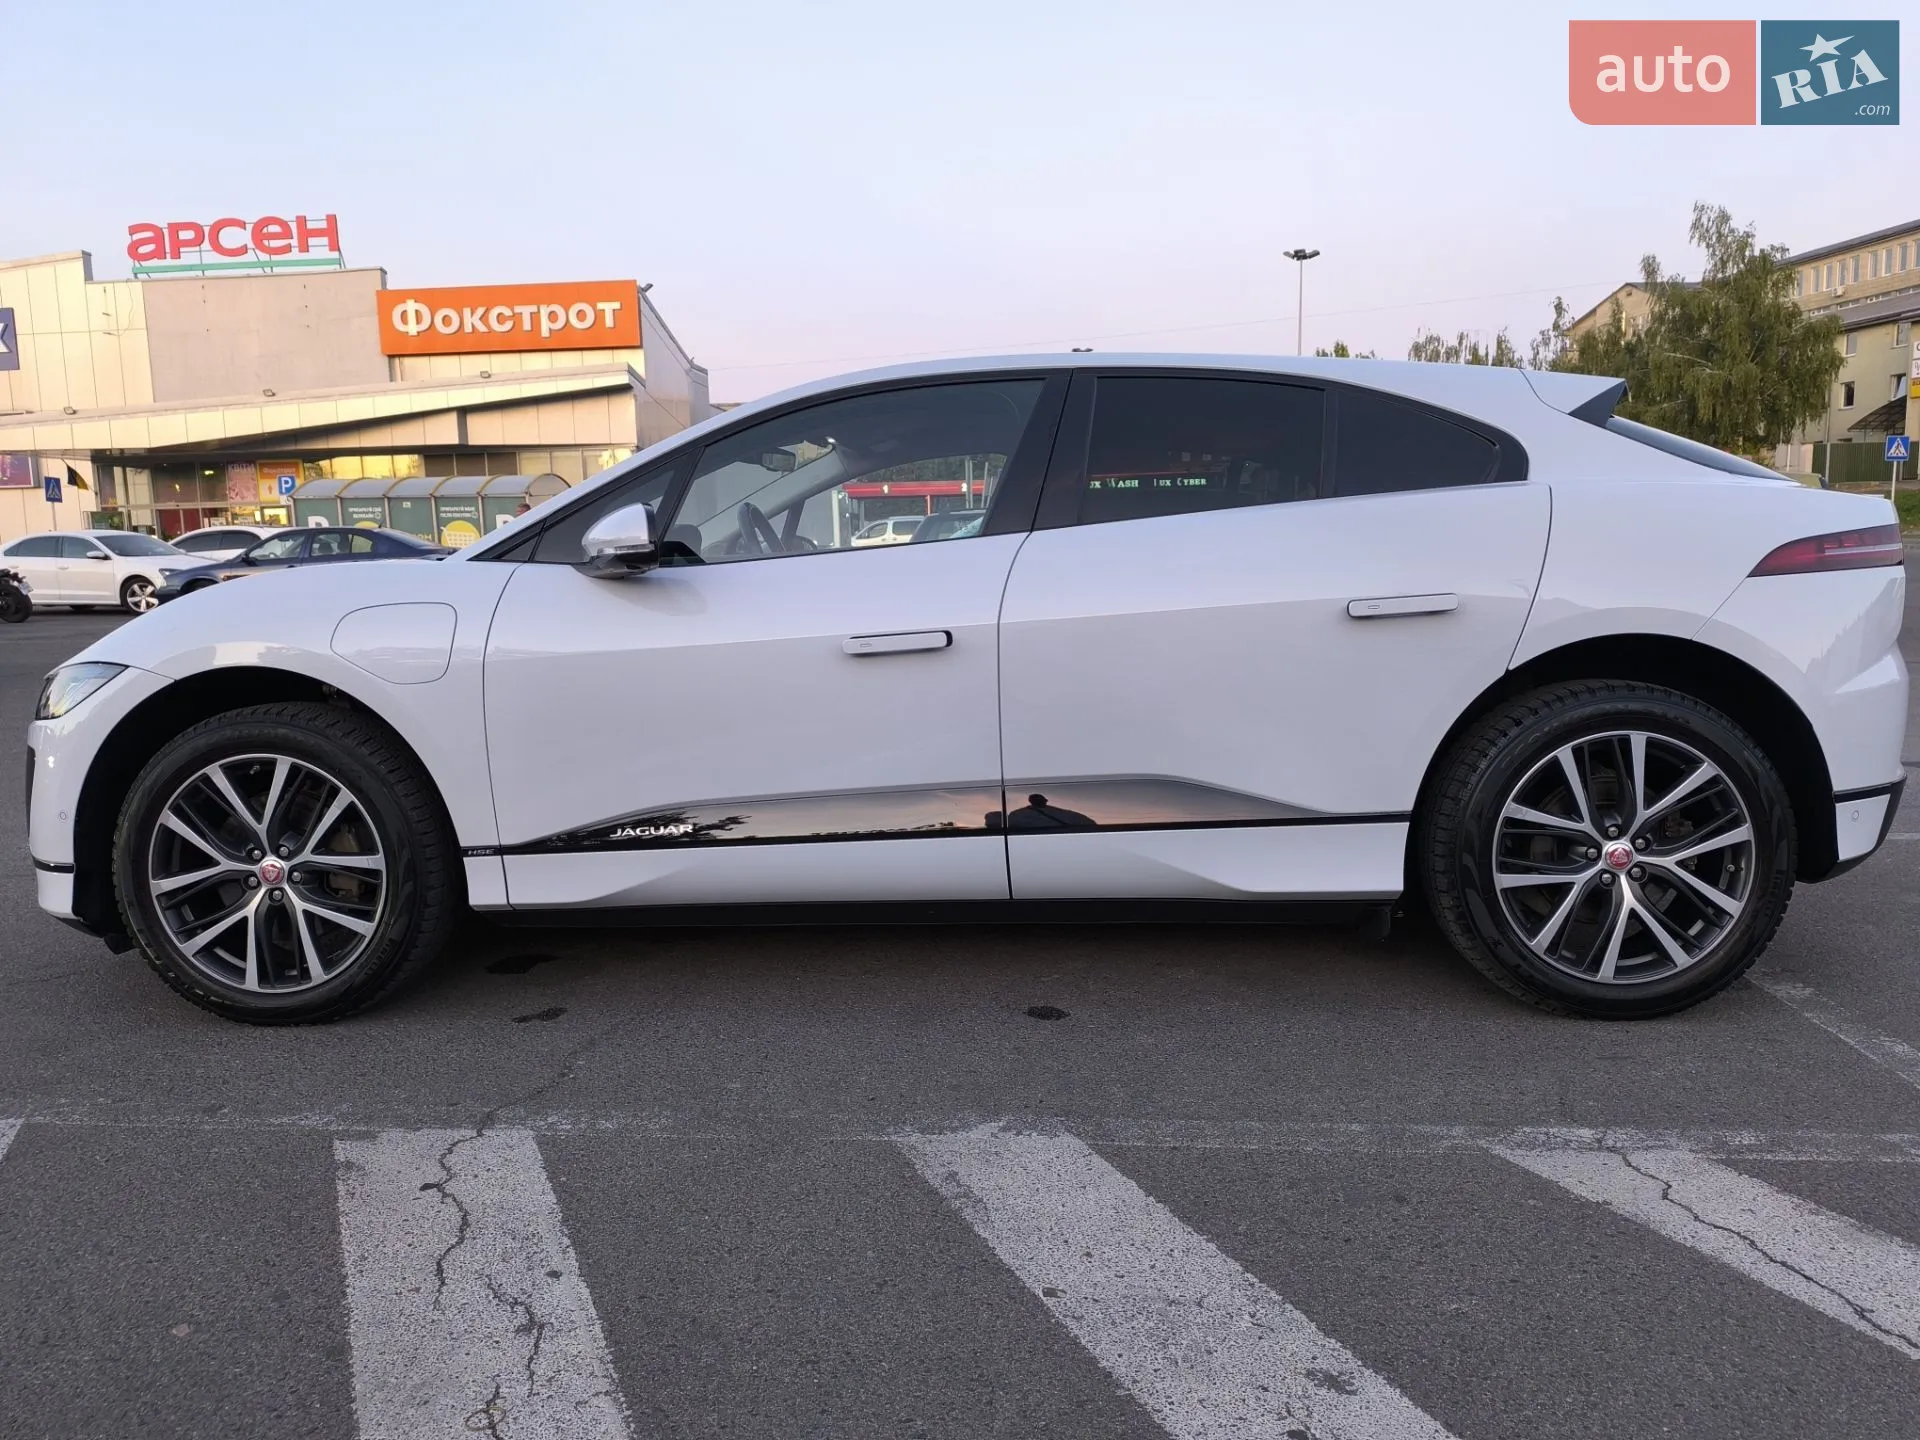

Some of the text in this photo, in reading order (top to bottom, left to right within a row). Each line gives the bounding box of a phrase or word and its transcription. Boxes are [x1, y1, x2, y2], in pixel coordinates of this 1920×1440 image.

[391, 299, 622, 338] Фокстрот
[280, 477, 292, 493] P
[610, 824, 693, 838] JAGUAR
